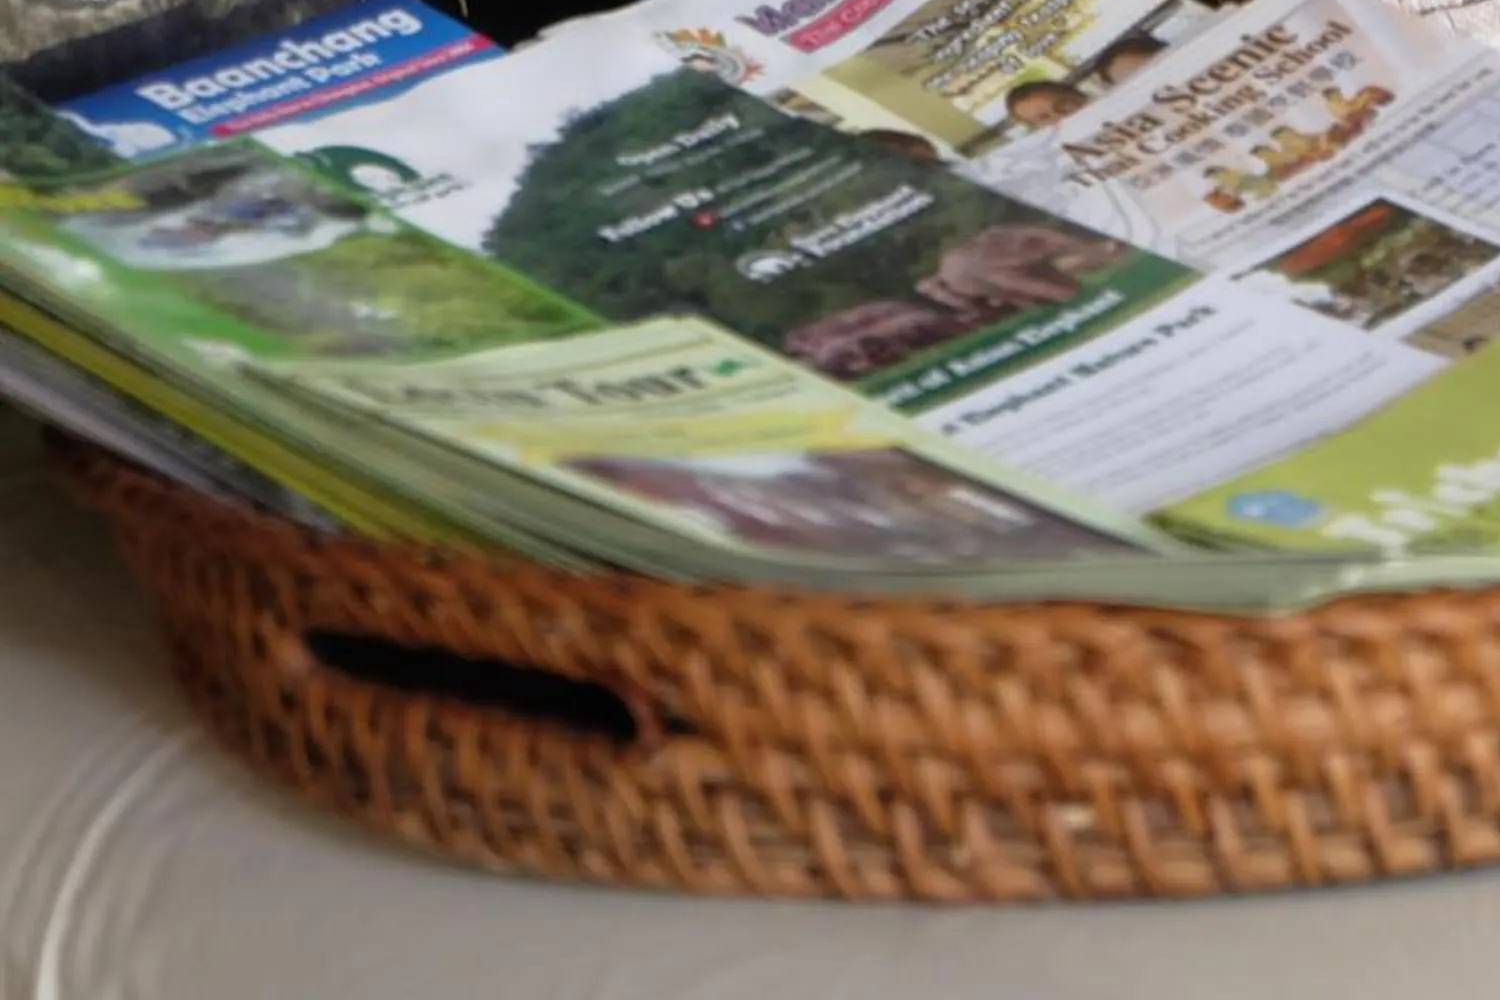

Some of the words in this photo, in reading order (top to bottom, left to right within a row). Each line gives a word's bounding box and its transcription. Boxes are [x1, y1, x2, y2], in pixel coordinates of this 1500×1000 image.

[136, 8, 423, 111] Baanchang
[178, 74, 313, 126] Elephant
[305, 50, 384, 85] Park
[1061, 112, 1165, 168] Asia
[1153, 21, 1298, 108] Scenic
[1137, 87, 1266, 154] Cooking
[1251, 20, 1352, 85] School
